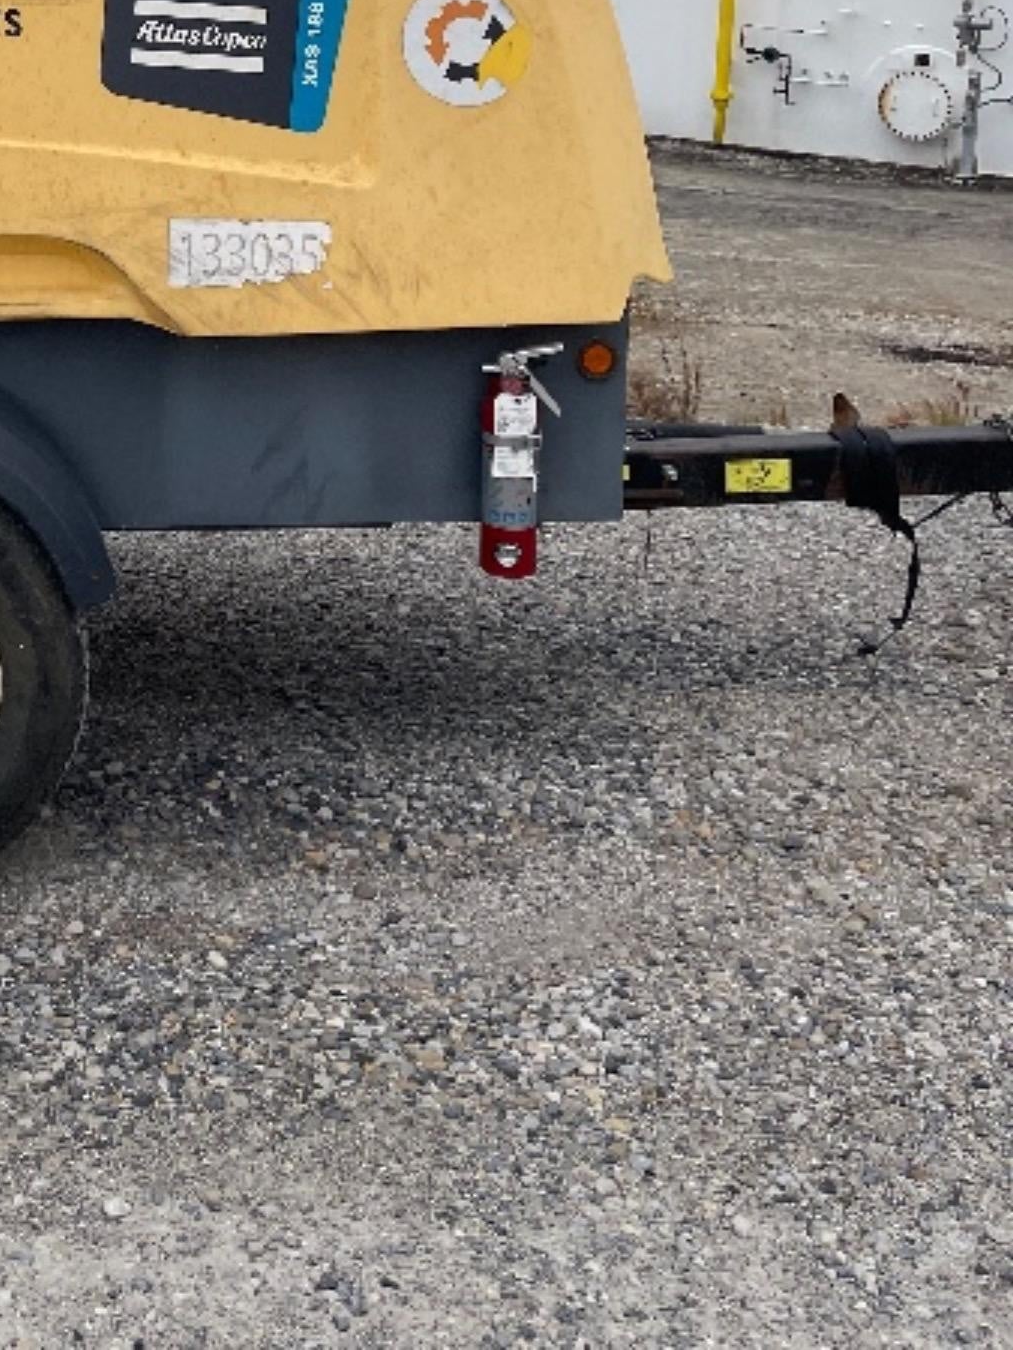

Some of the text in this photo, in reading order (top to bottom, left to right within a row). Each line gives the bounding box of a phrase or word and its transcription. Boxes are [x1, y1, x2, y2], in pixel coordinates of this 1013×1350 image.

[135, 19, 201, 46] Atlas
[301, 43, 322, 88] XAS
[181, 232, 320, 276] 133035
